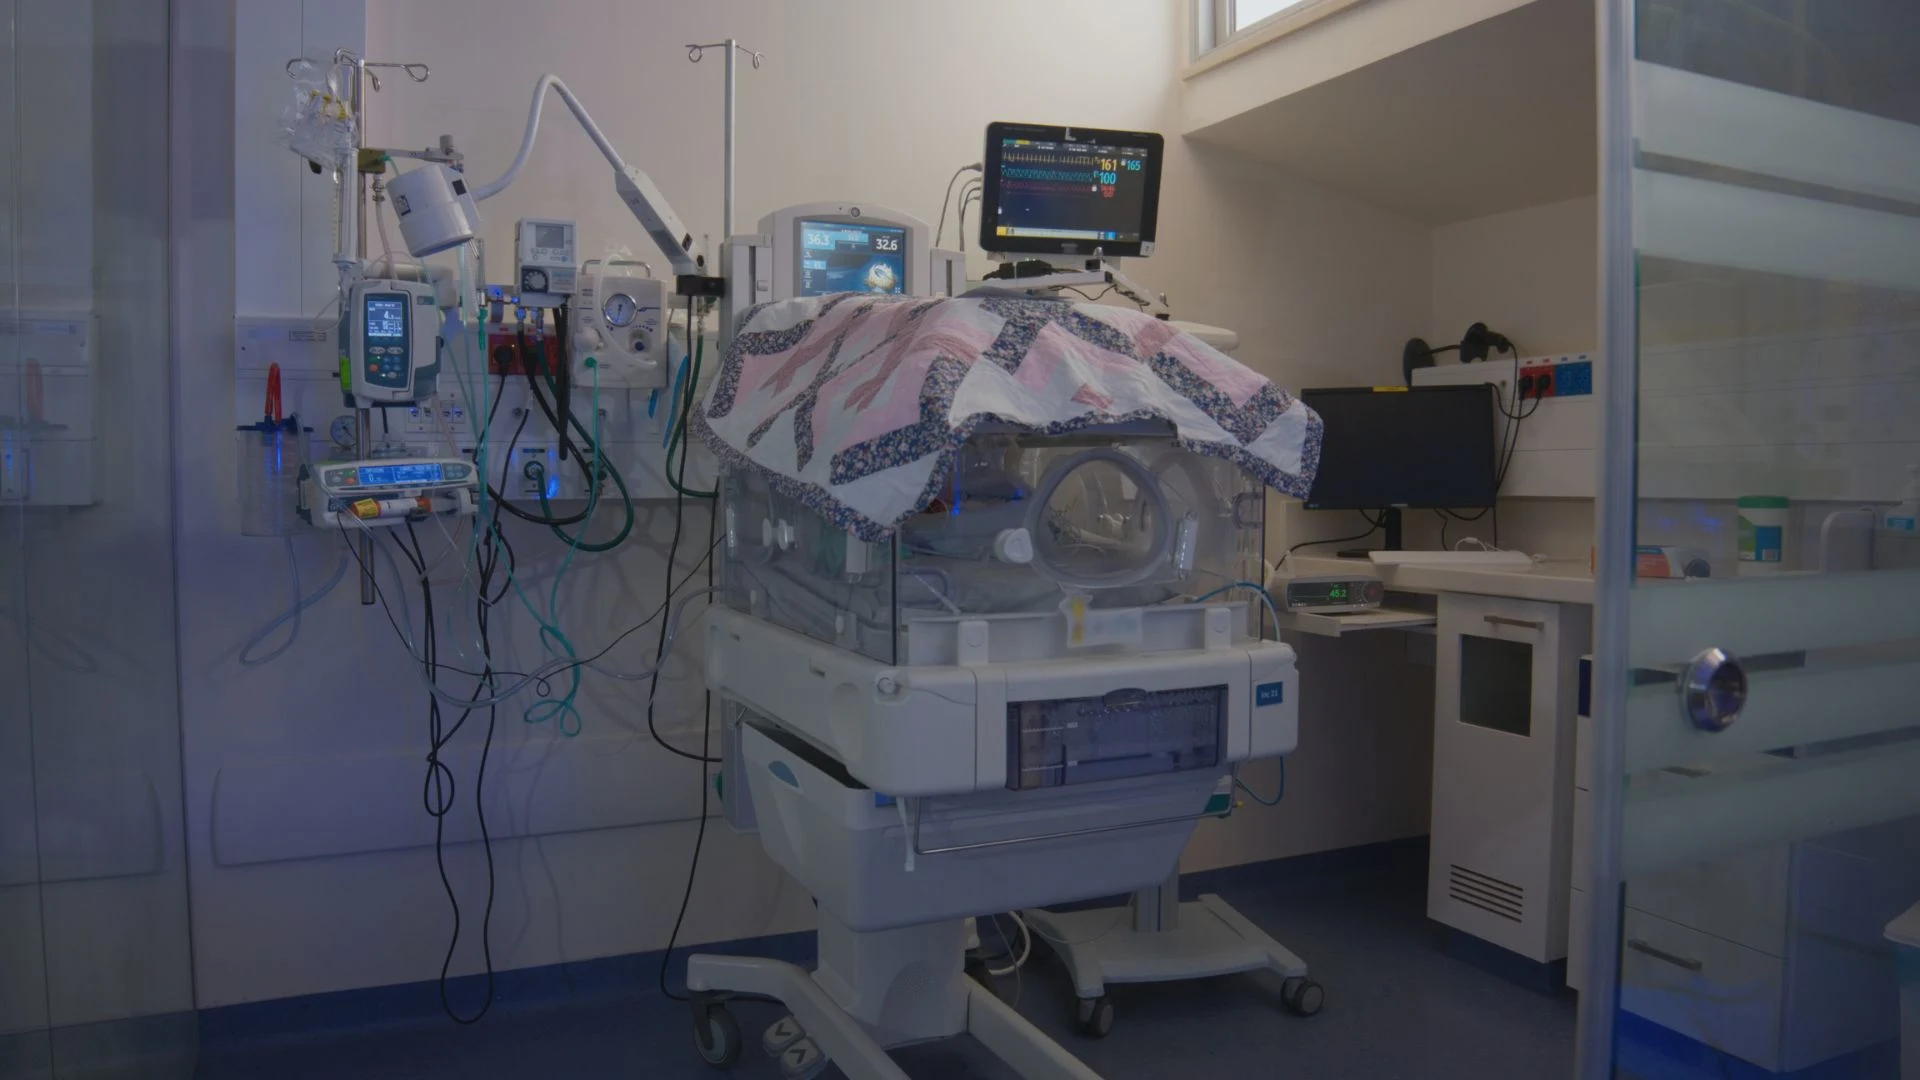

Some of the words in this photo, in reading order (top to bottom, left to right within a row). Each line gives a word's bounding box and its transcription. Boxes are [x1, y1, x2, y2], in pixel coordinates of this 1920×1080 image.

[1101, 158, 1117, 171] 161
[1127, 159, 1142, 171] 165
[1100, 171, 1116, 185] 100
[875, 238, 898, 251] 32.6
